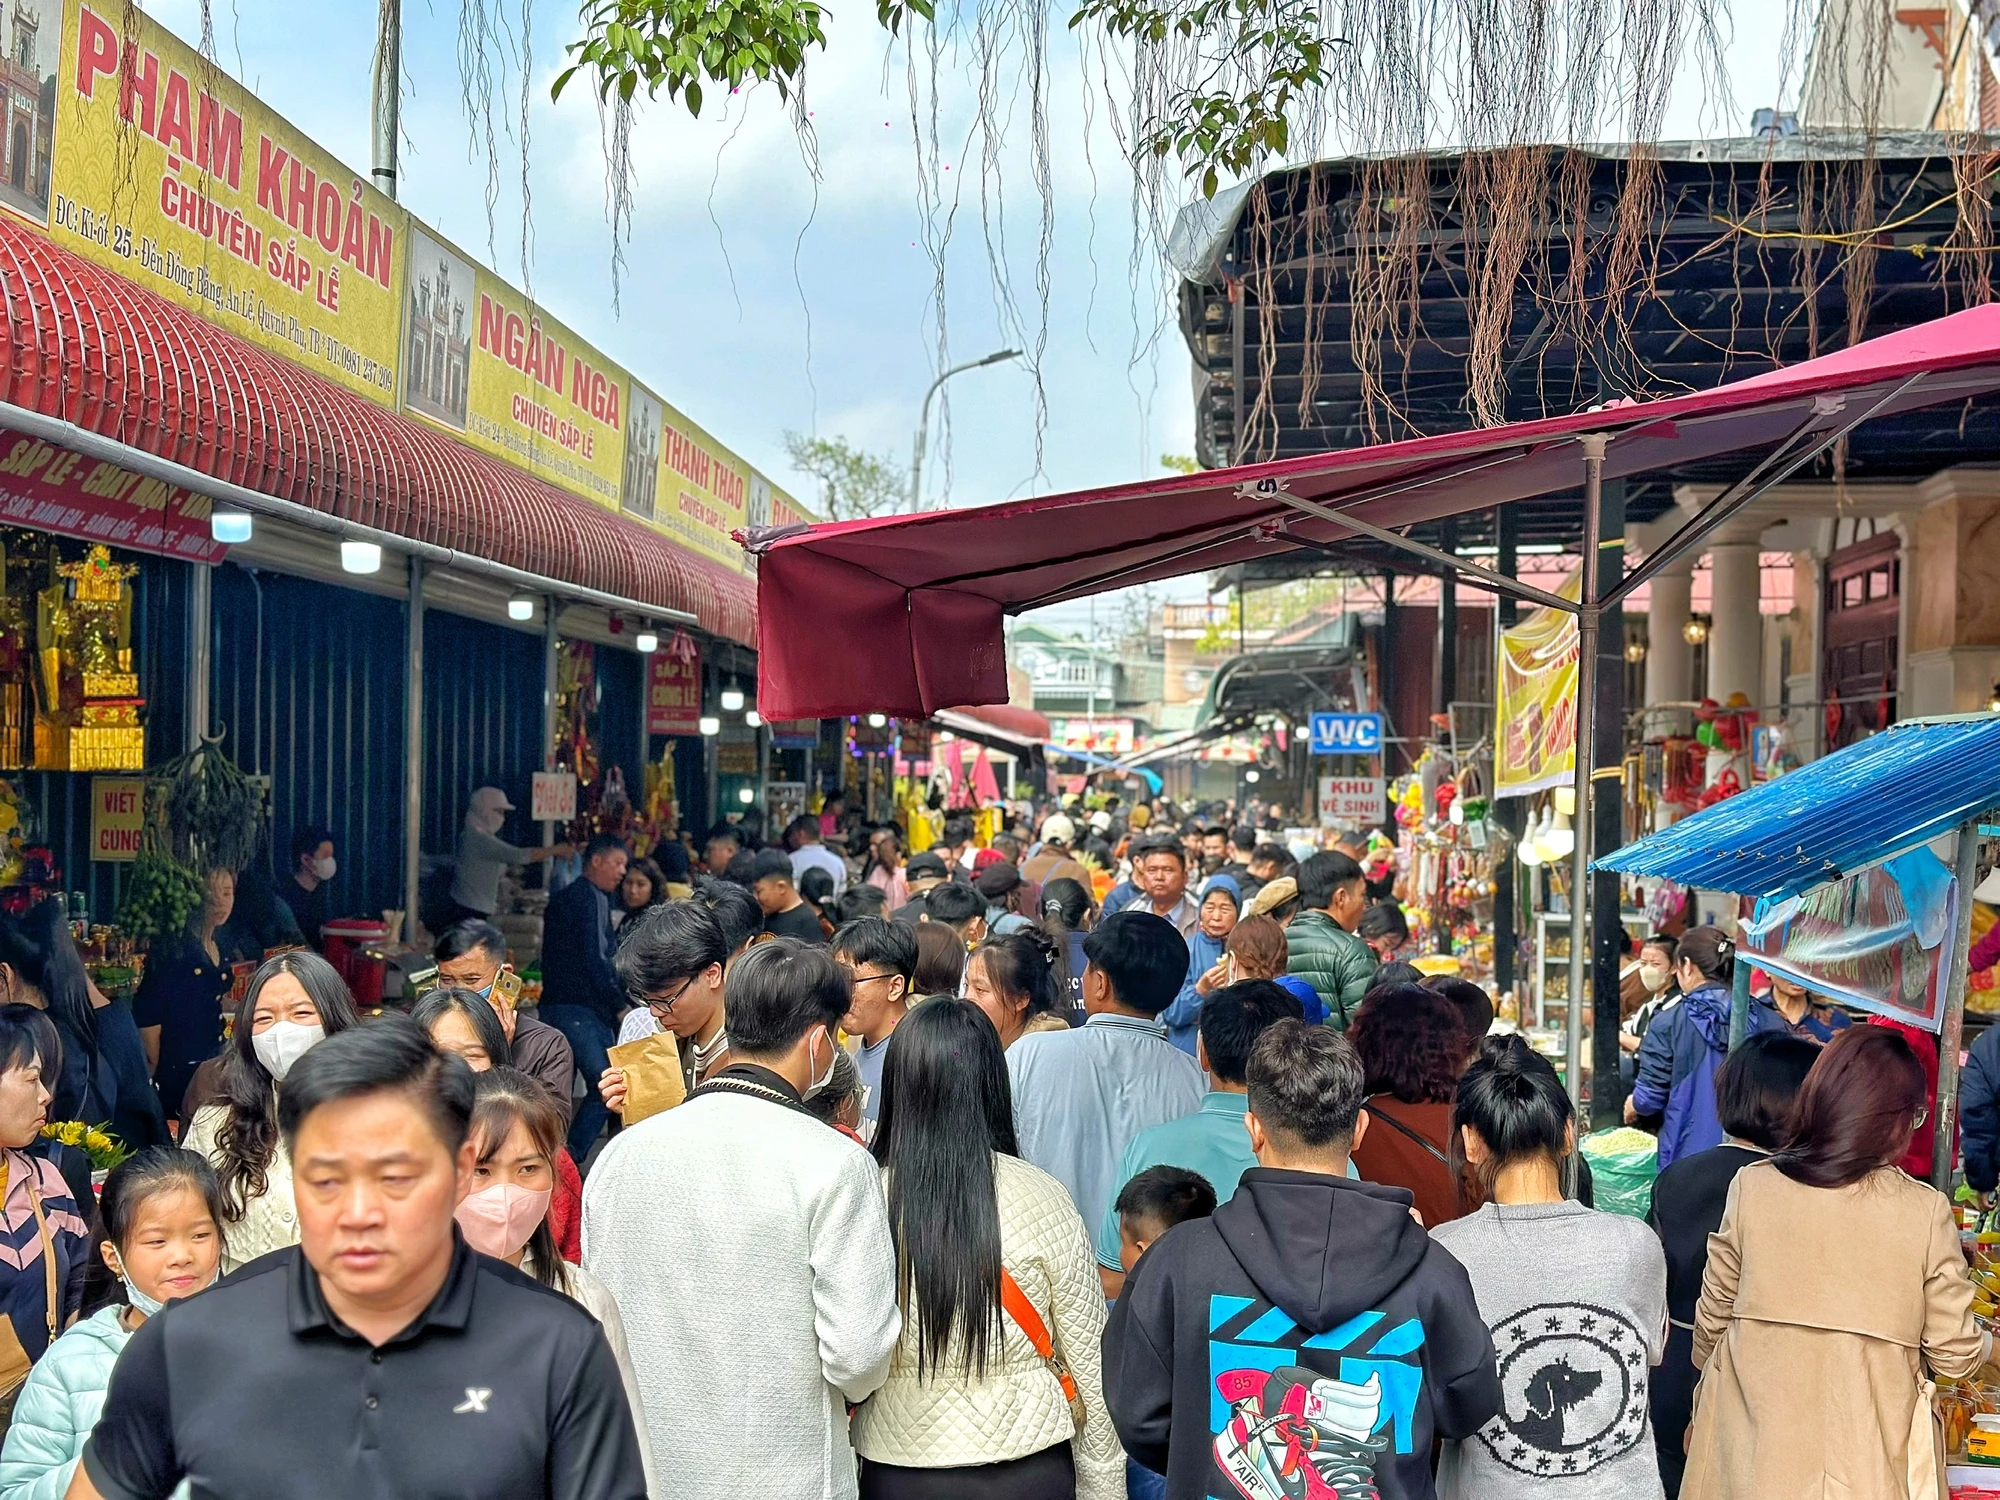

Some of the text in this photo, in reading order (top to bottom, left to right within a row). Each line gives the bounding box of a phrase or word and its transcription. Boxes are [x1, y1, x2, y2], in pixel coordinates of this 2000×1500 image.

[76, 8, 393, 289] PHẠM KHOẢN
[55, 195, 77, 233] ĐC:
[80, 206, 108, 247] Ki-ốt
[113, 224, 132, 259] 25
[141, 236, 163, 275] Đền
[166, 249, 194, 297] Đồng
[226, 284, 239, 314] An
[161, 176, 340, 313] CHUYÊN SẮP LỄ
[479, 293, 619, 431] NGÂN NGA
[492, 422, 500, 444] 24
[513, 394, 557, 441] CHUYÊN
[559, 418, 580, 452] SẮP
[664, 425, 710, 490] THÀNH
[713, 459, 743, 511] THẢO
[679, 491, 705, 523] CHUYÊN
[1317, 718, 1376, 747] WC
[1331, 781, 1374, 795] KHU
[1344, 800, 1379, 813] SINH
[1234, 1460, 1264, 1491] "AIR"
